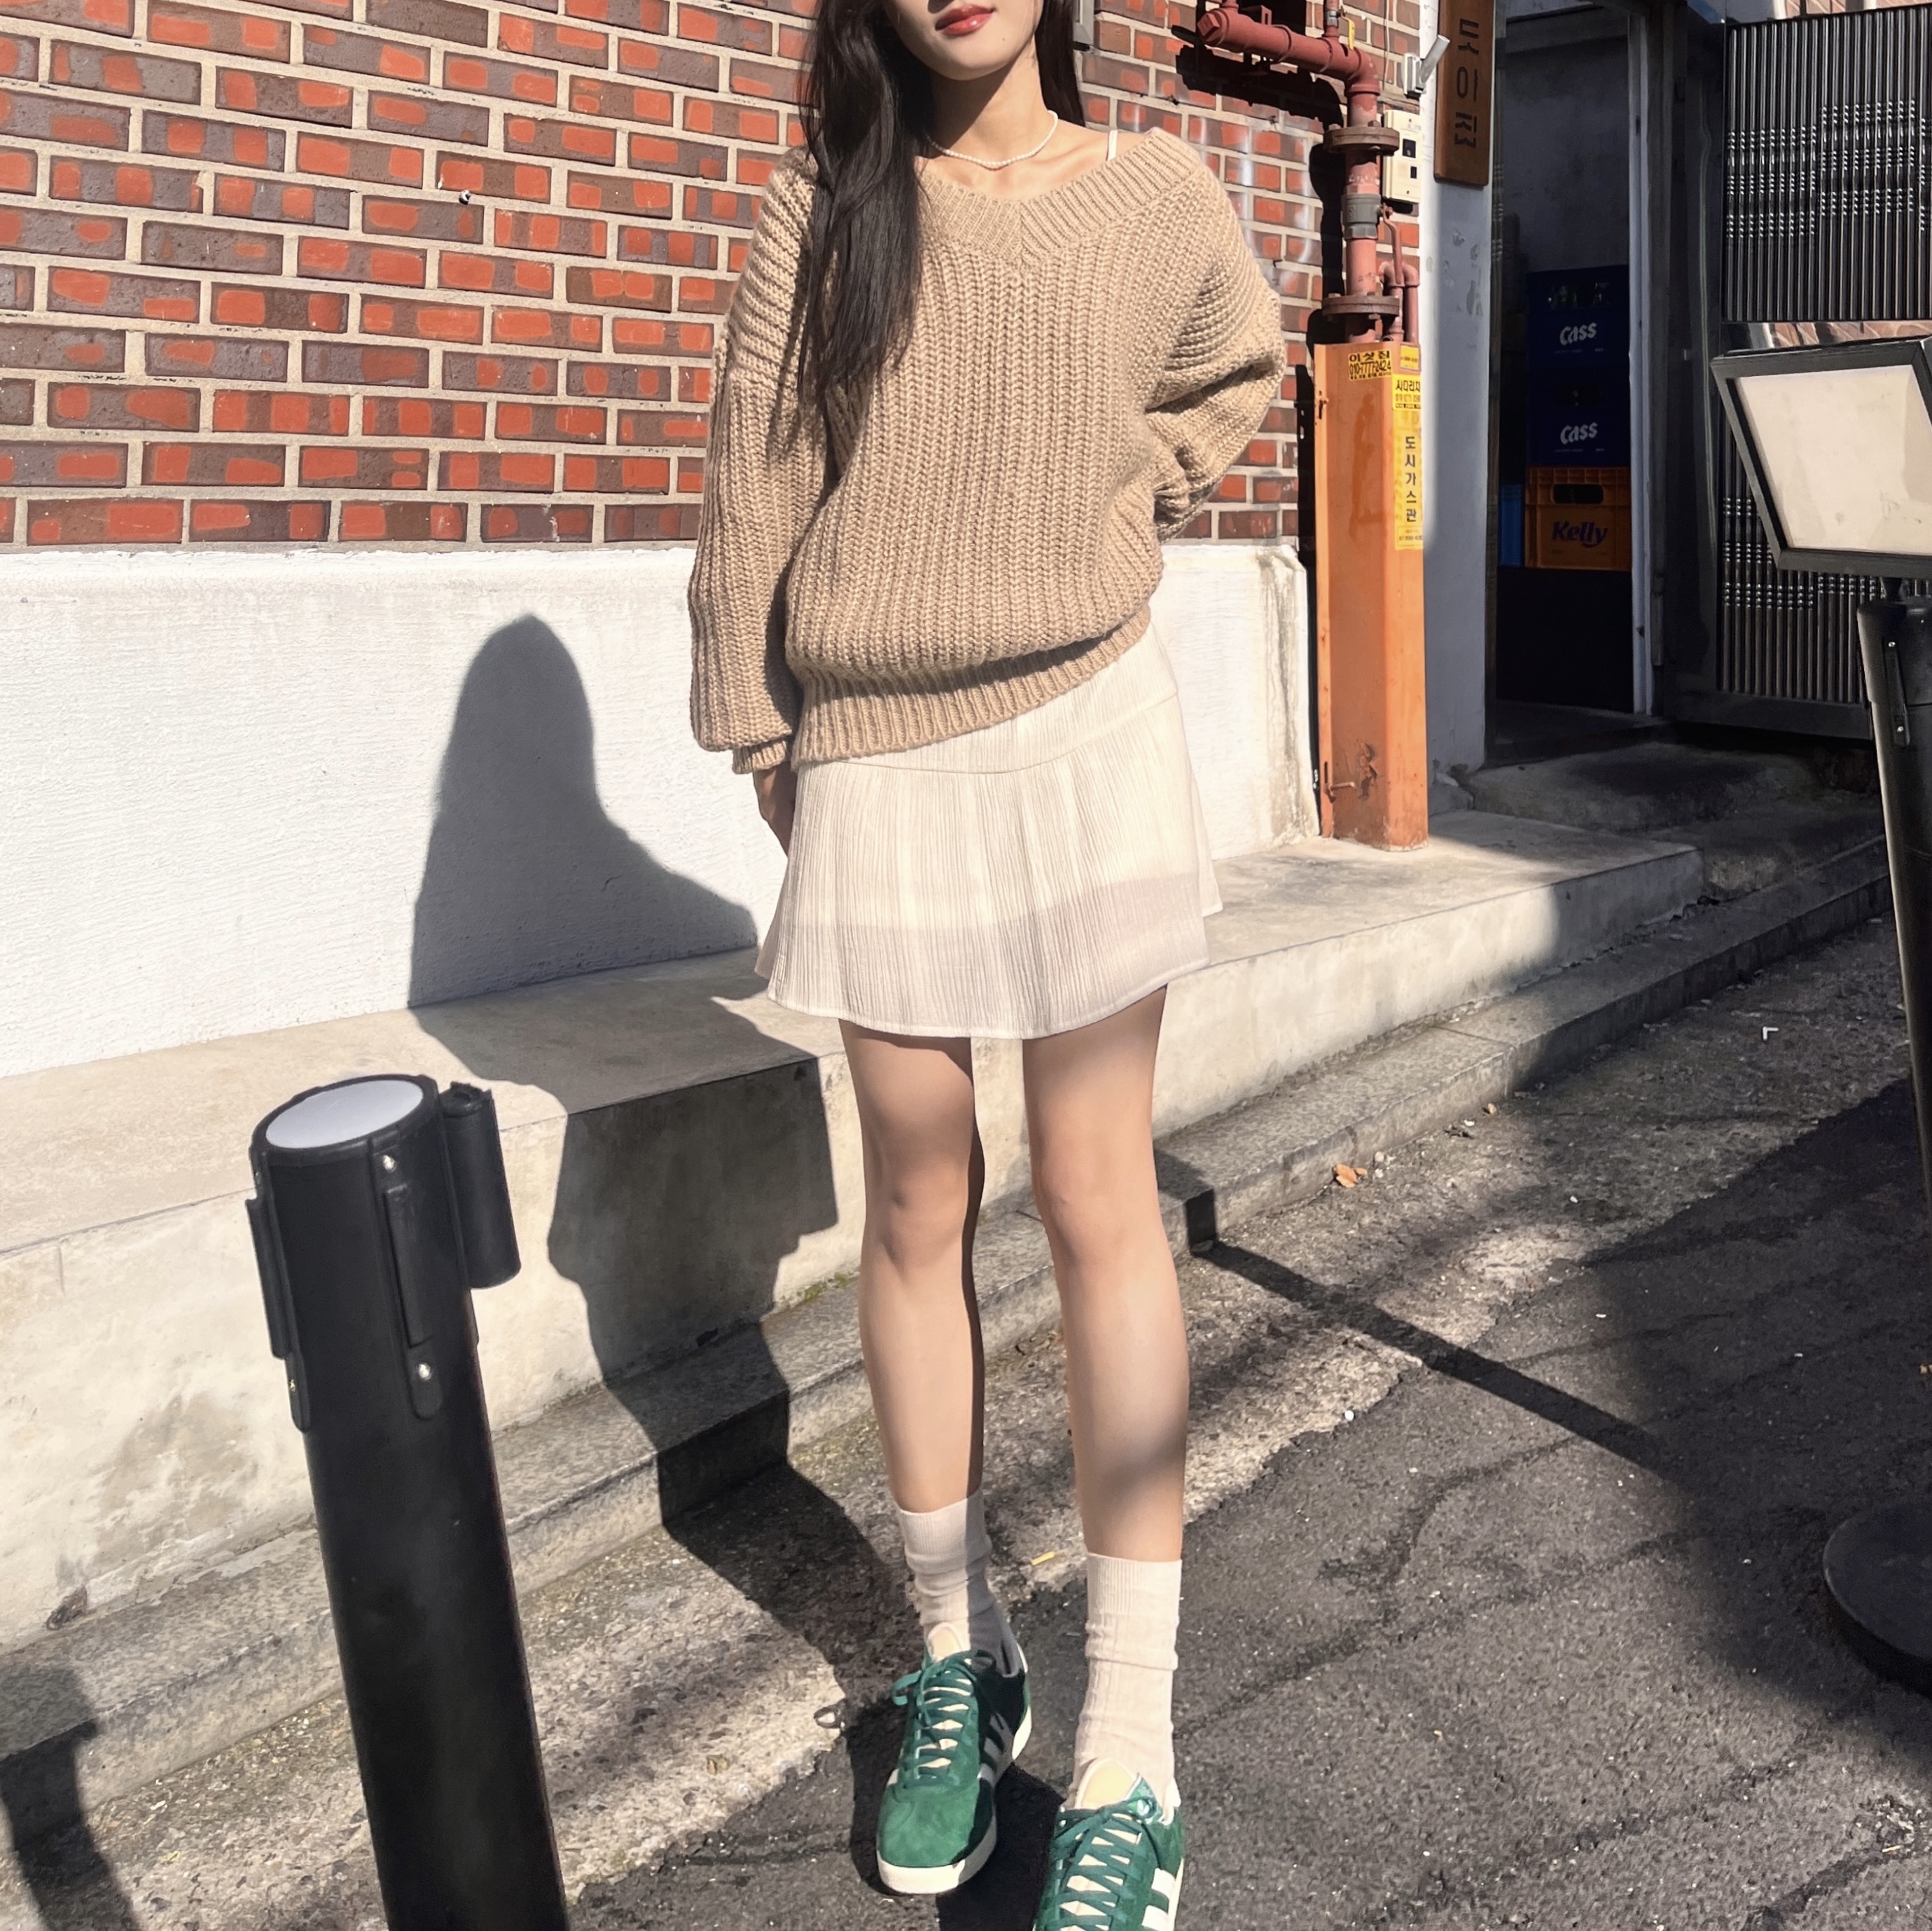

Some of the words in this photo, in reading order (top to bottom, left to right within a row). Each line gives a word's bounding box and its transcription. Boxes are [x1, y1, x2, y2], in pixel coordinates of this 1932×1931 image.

[1560, 322, 1597, 345] Cass
[1560, 422, 1598, 445] Cass
[1405, 436, 1417, 522] 도시가스관
[1552, 521, 1608, 548] Kelly
